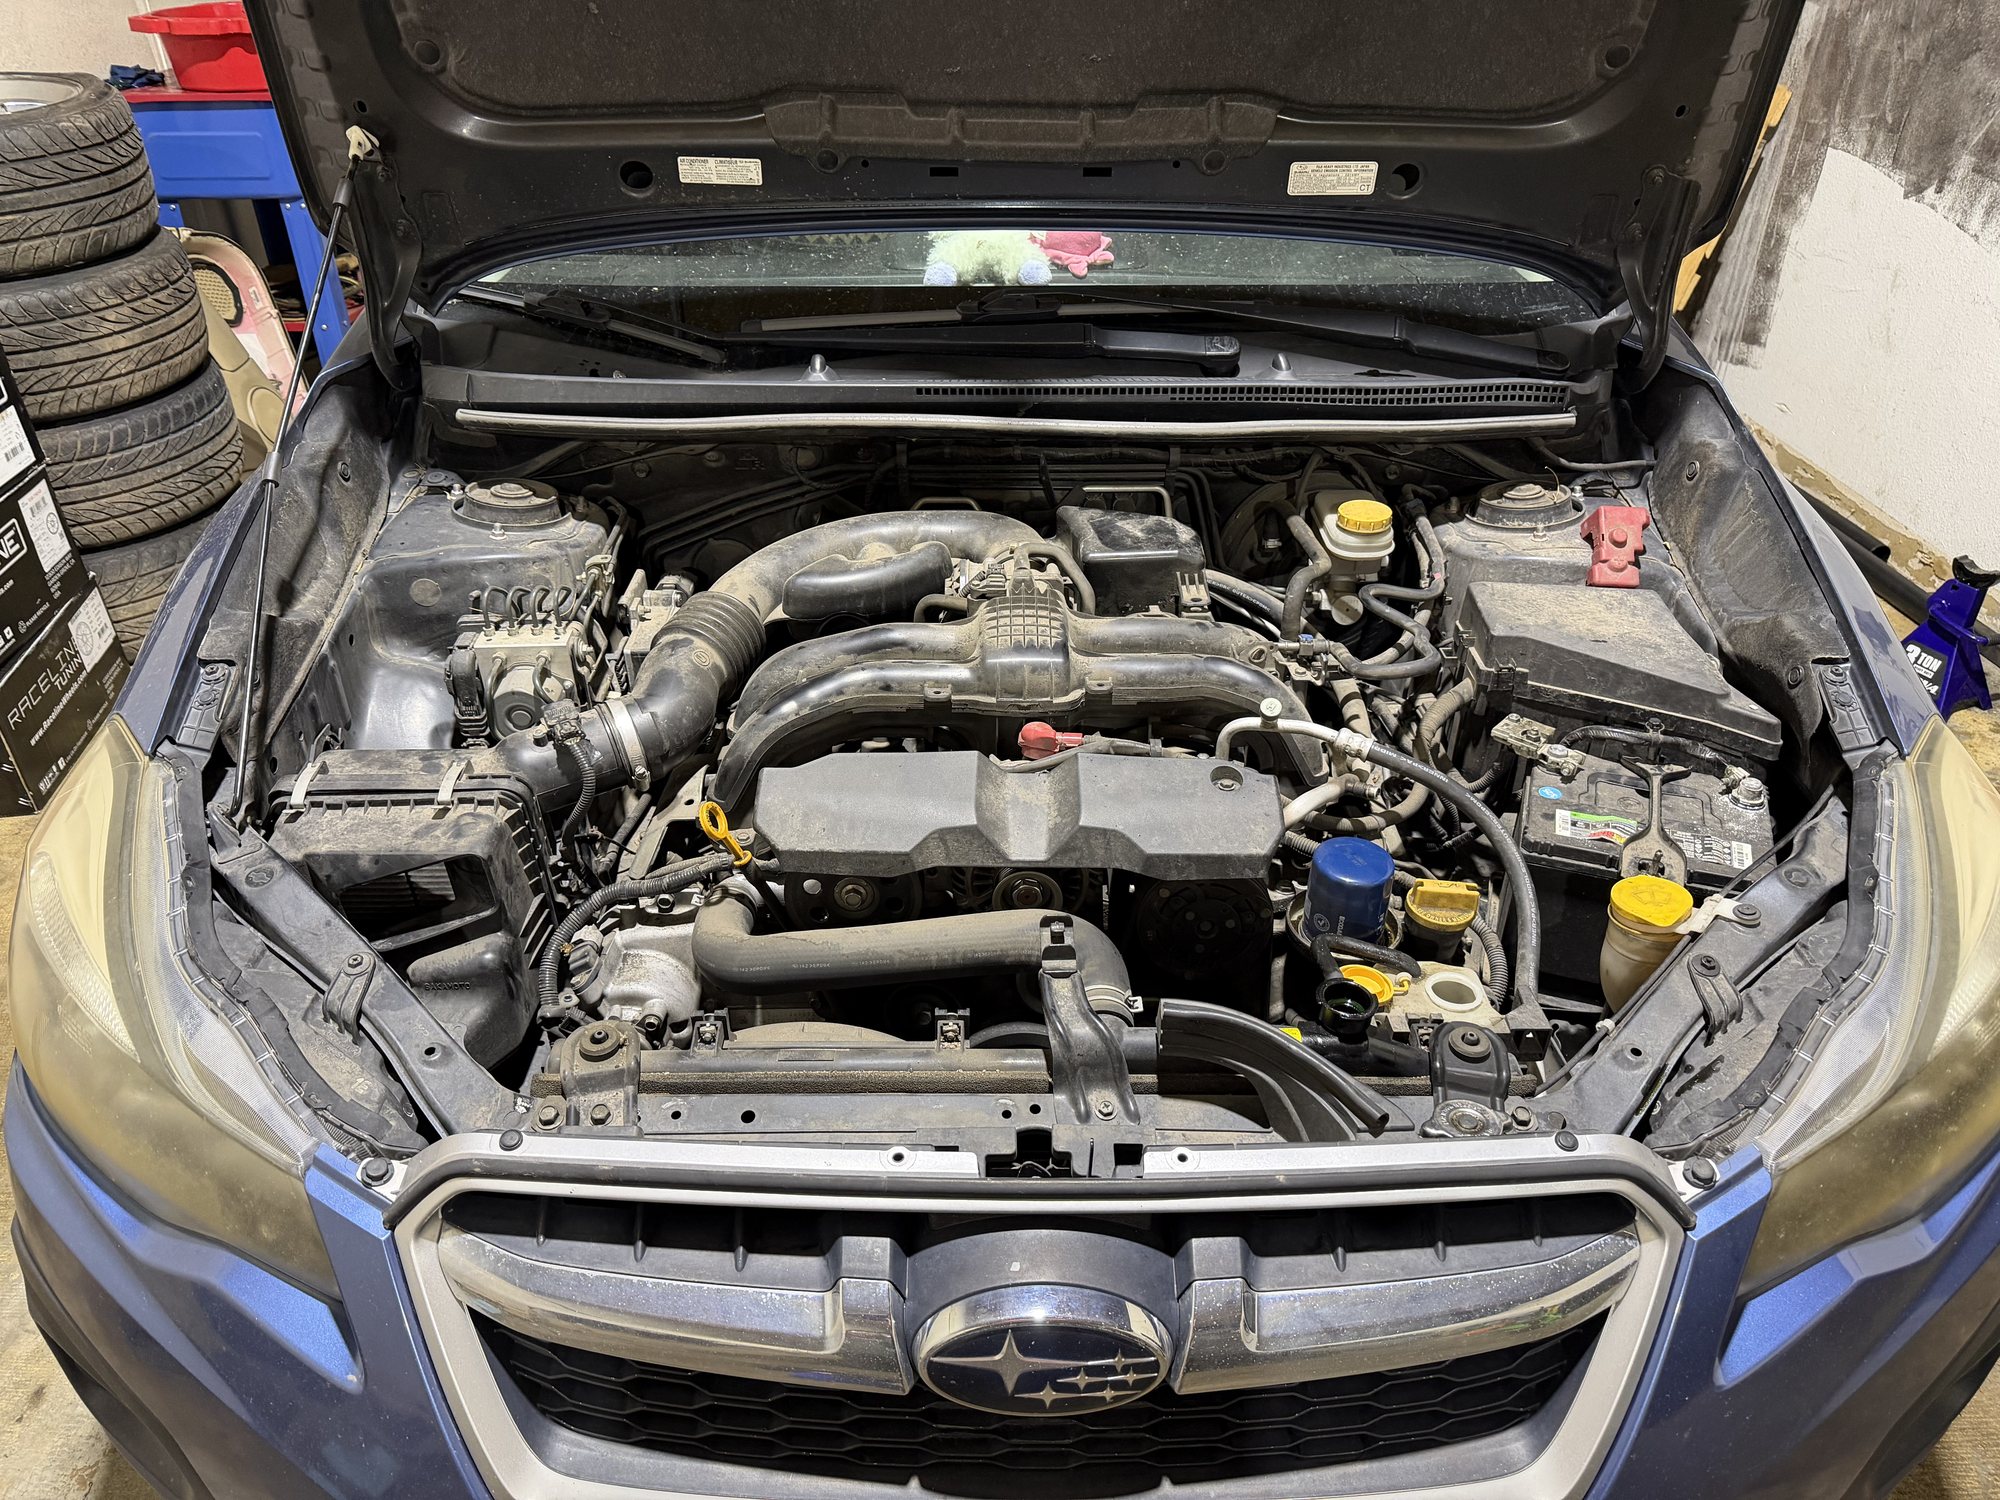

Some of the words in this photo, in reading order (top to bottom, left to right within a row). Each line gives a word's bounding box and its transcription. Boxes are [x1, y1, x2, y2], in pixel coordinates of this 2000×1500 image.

[1360, 184, 1371, 192] CT
[54, 653, 83, 691] TUNIN
[1917, 652, 1942, 672] TON
[29, 669, 88, 747] www.RacelineWheels.com
